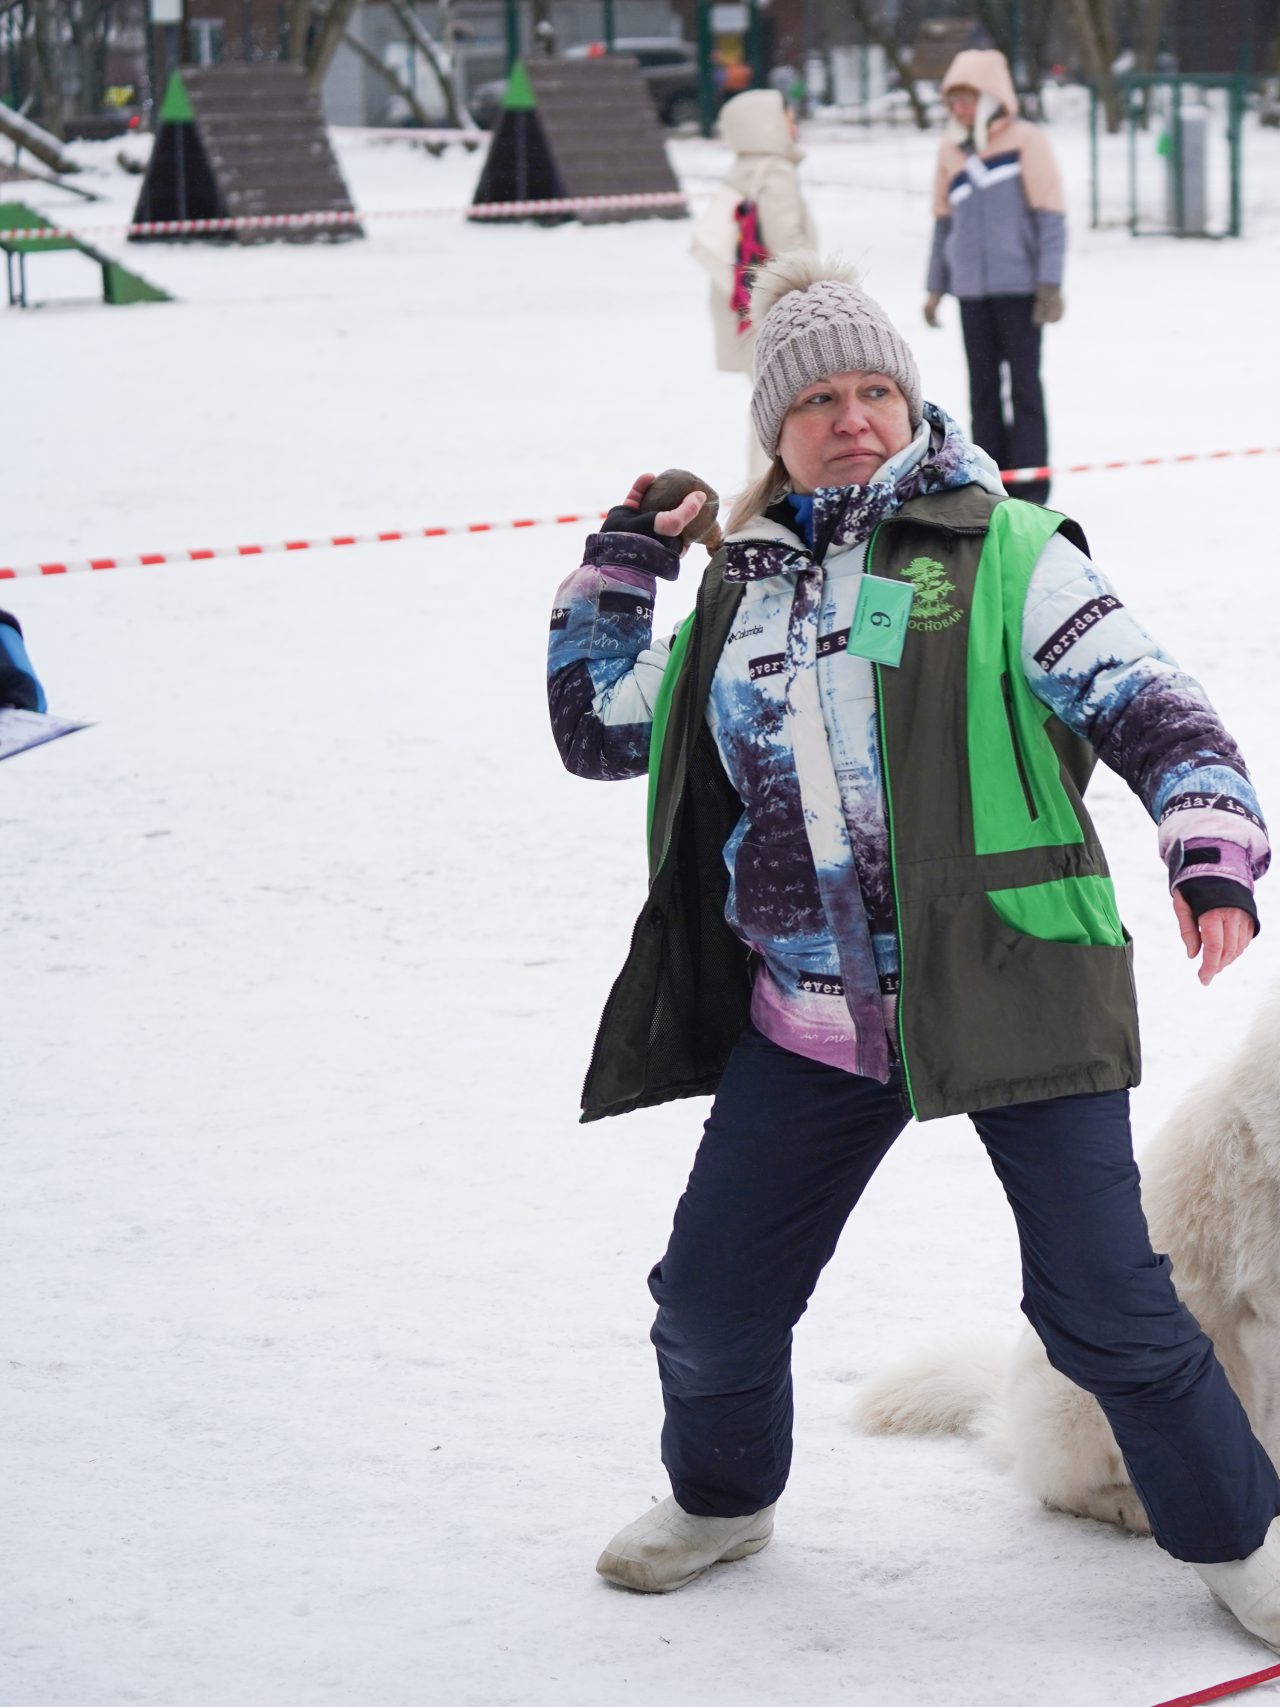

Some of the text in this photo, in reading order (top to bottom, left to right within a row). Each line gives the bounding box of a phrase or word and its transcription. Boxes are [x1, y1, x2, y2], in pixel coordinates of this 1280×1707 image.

[908, 610, 963, 632] ОСНОВАЯ
[734, 625, 764, 641] Columbia
[1040, 605, 1104, 670] everyday
